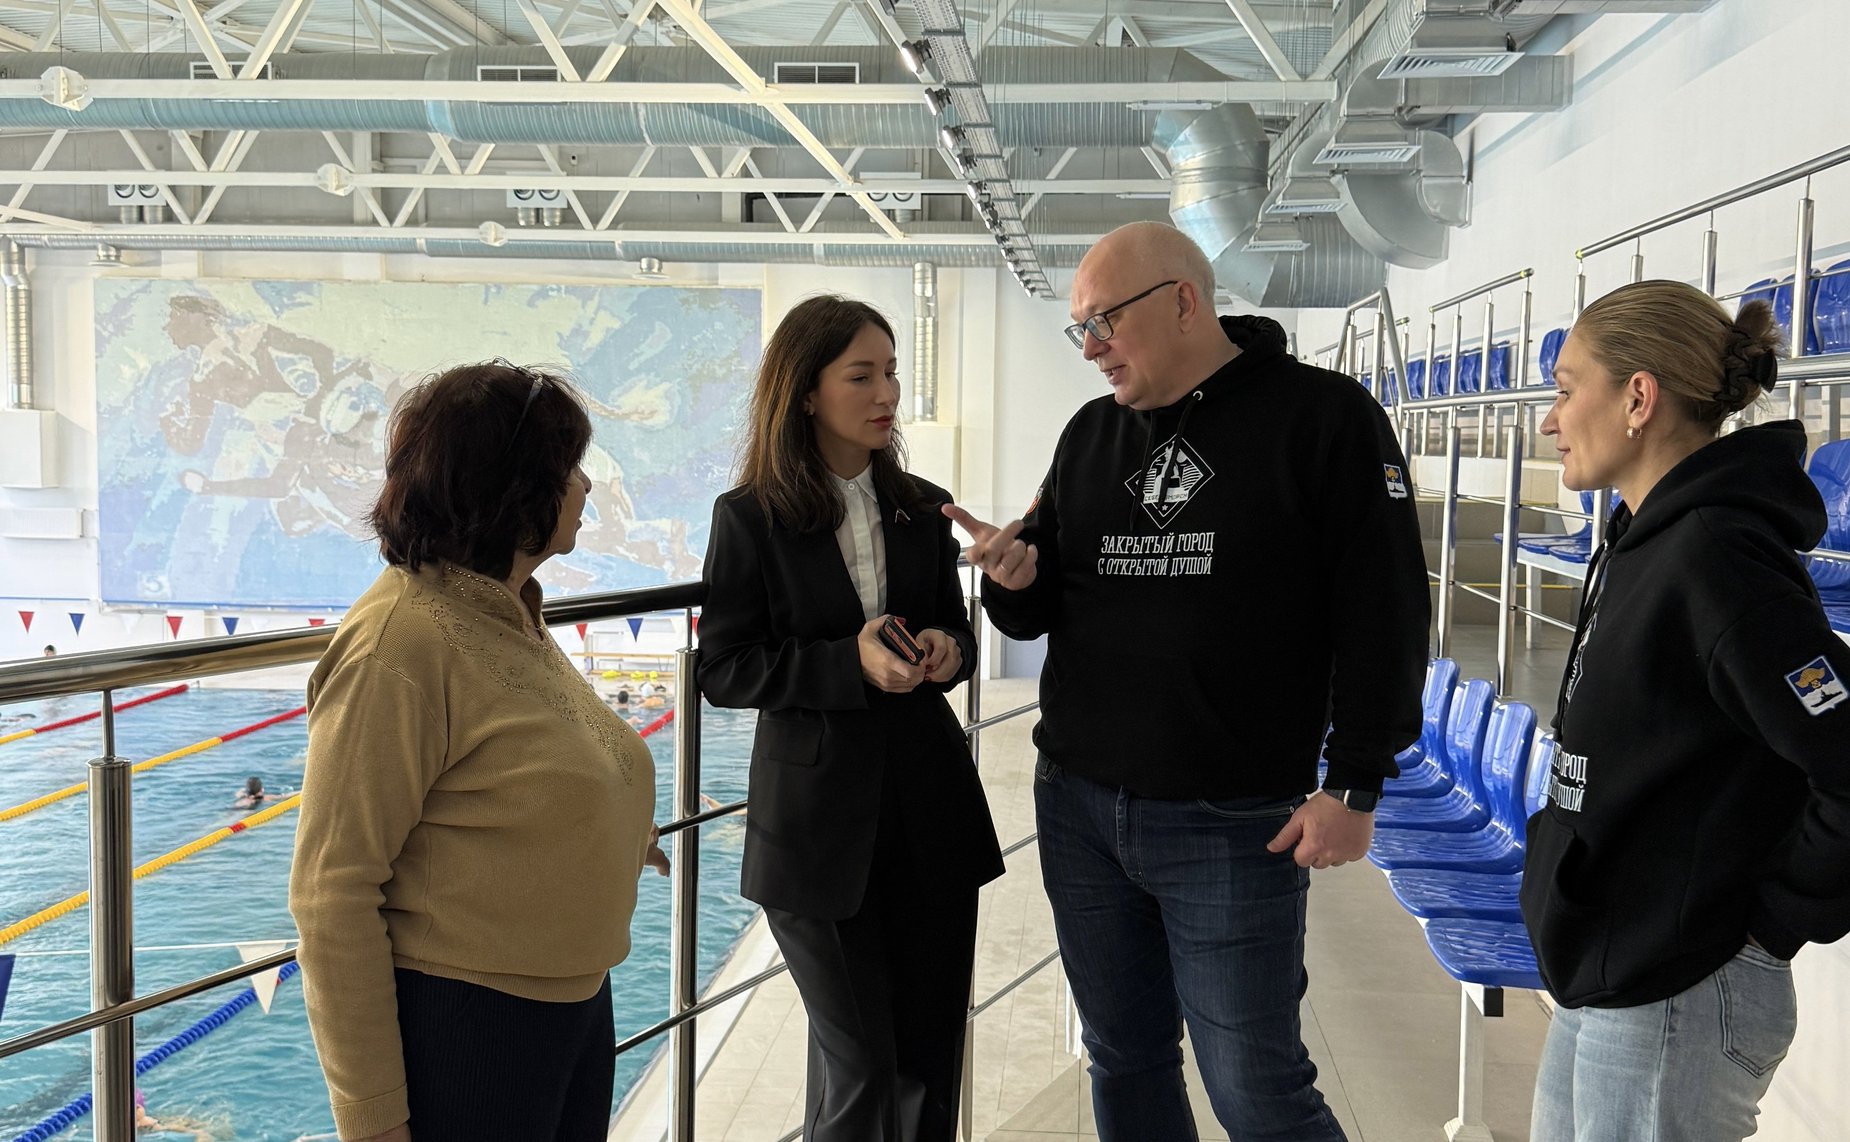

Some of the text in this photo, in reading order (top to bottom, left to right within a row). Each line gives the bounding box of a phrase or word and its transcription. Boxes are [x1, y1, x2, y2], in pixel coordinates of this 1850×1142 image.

[1101, 532, 1215, 555] ЗАКРЫТЫЙ ГОРОД
[1098, 553, 1212, 577] С ОТКРЫТОЙ ДУШОЙ
